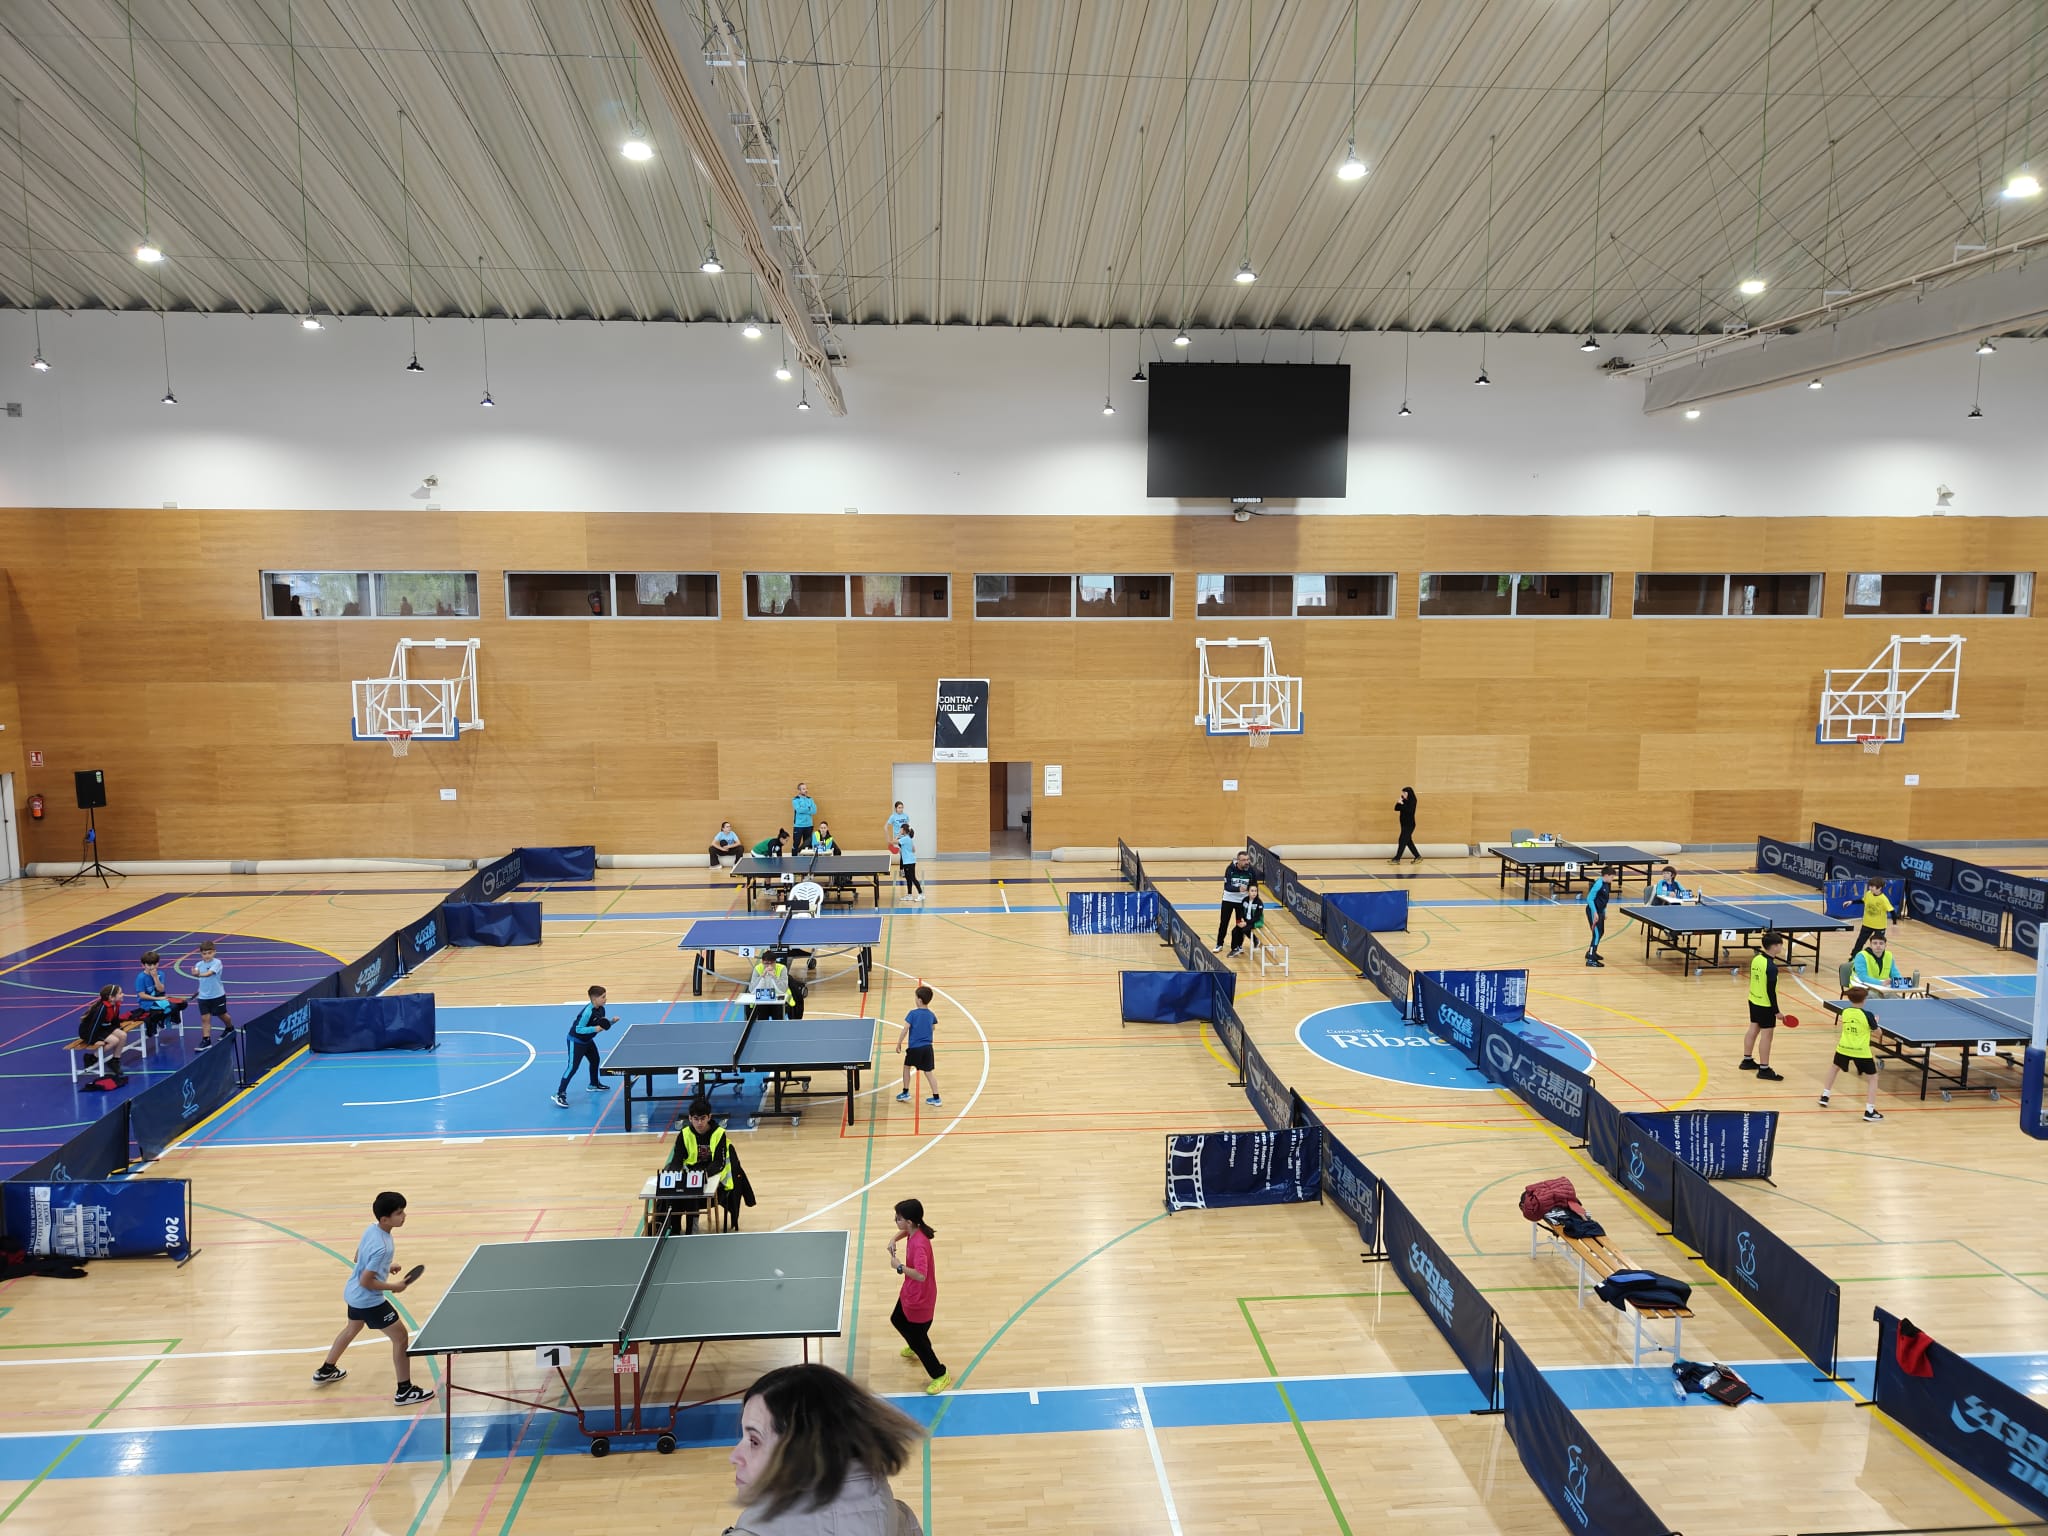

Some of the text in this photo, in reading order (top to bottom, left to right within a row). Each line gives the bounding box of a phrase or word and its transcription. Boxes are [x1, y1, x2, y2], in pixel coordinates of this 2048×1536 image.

[939, 696, 972, 704] CONTRA
[1568, 862, 1574, 870] 8
[1782, 863, 1824, 880] GAC GROUP
[1984, 890, 2044, 911] GAC GROUP
[1935, 912, 1998, 935] GAC GROUP
[1724, 932, 1732, 940] 7
[742, 948, 750, 956] 3
[1452, 1028, 1474, 1049] DHS
[1980, 1042, 1991, 1053] 6
[682, 1069, 694, 1080] 2
[1512, 1054, 1583, 1108] 广汽集团
[1512, 1072, 1581, 1118] GAC GROUP
[664, 1175, 672, 1186] 0
[691, 1174, 698, 1186] 0
[1337, 1183, 1372, 1224] GROUP
[165, 1216, 180, 1248] 2002
[543, 1348, 560, 1367] 1
